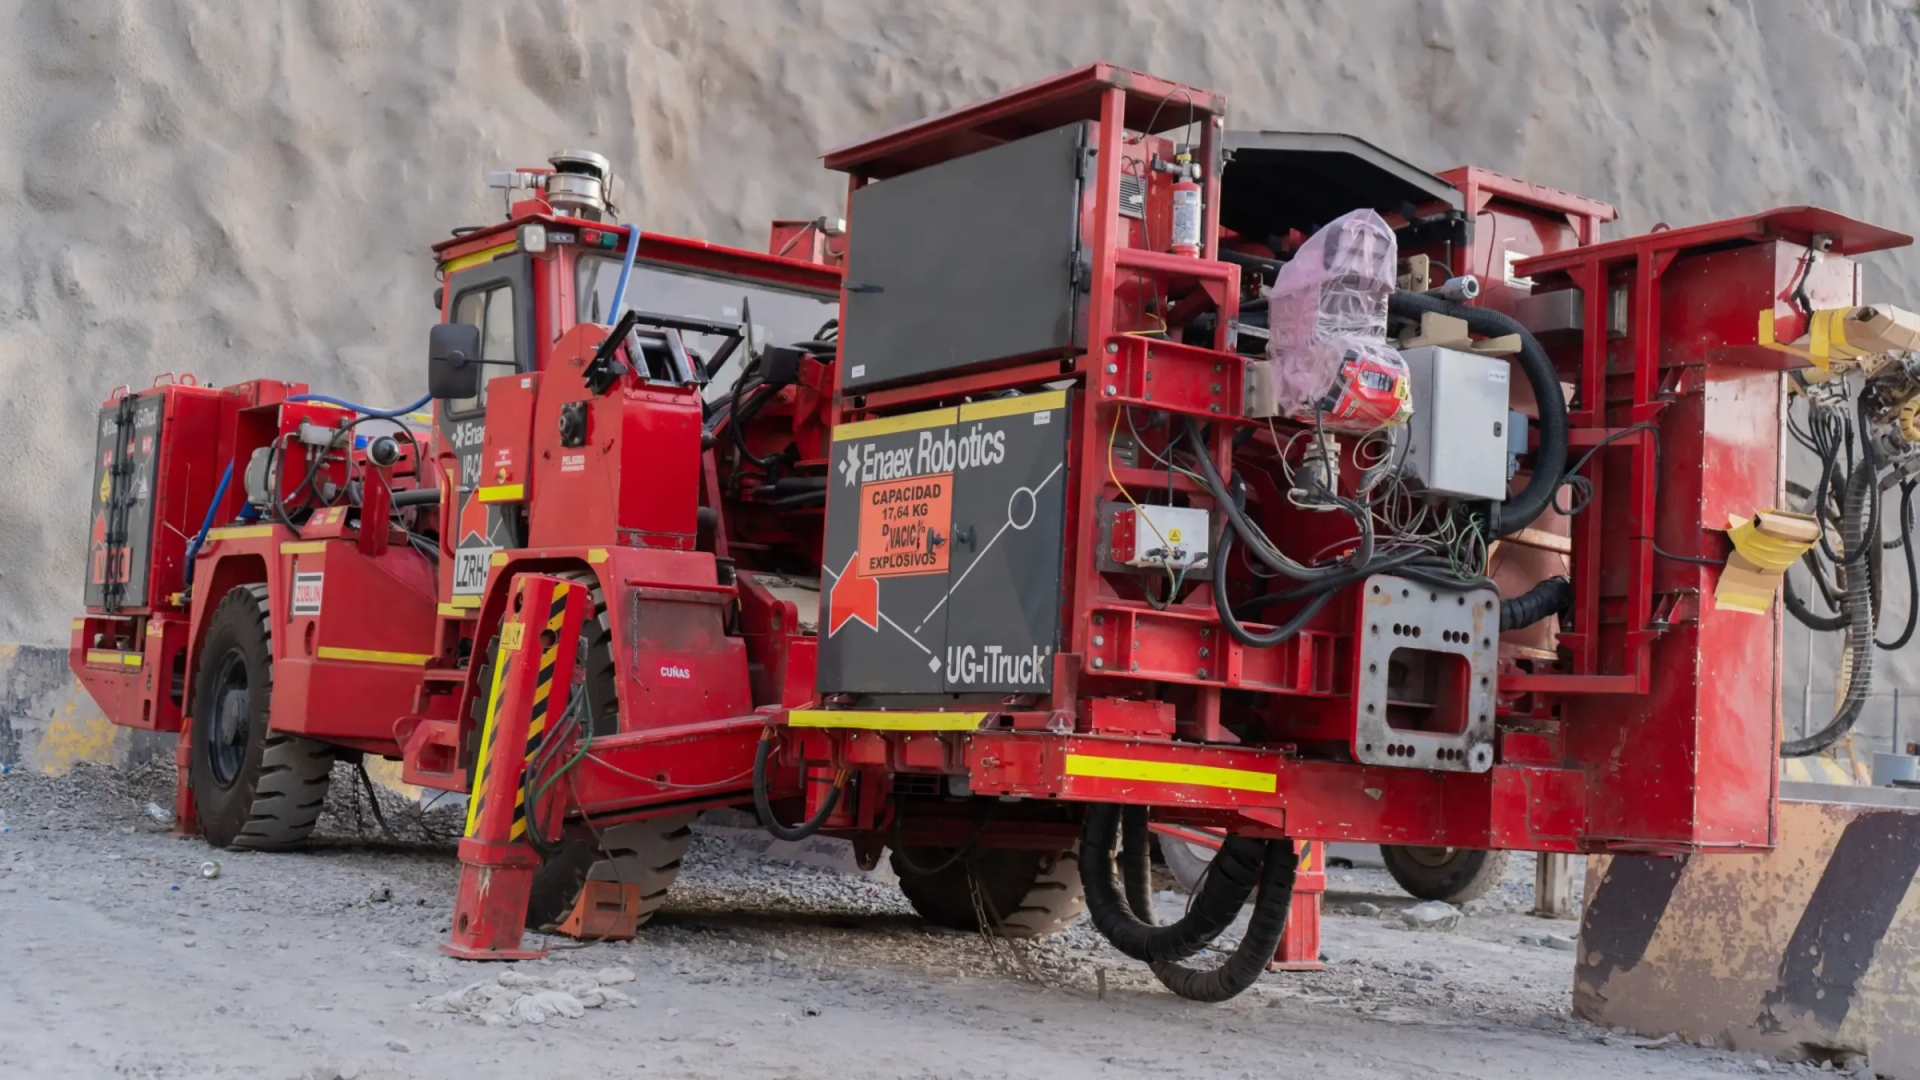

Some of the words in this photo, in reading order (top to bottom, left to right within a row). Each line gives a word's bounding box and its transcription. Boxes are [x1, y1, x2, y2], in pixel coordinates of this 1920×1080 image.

[561, 454, 585, 467] PELIGRO
[861, 443, 914, 482] Enaex
[917, 423, 1005, 473] Robotics
[872, 483, 942, 505] CAPACIDAD
[882, 505, 909, 521] 17,64
[912, 503, 928, 517] KG
[456, 553, 493, 588] LZRH-
[869, 552, 937, 569] EXPLOSIVOS
[660, 665, 691, 679] CUÑAS
[947, 645, 1047, 684] UG-iTruck
